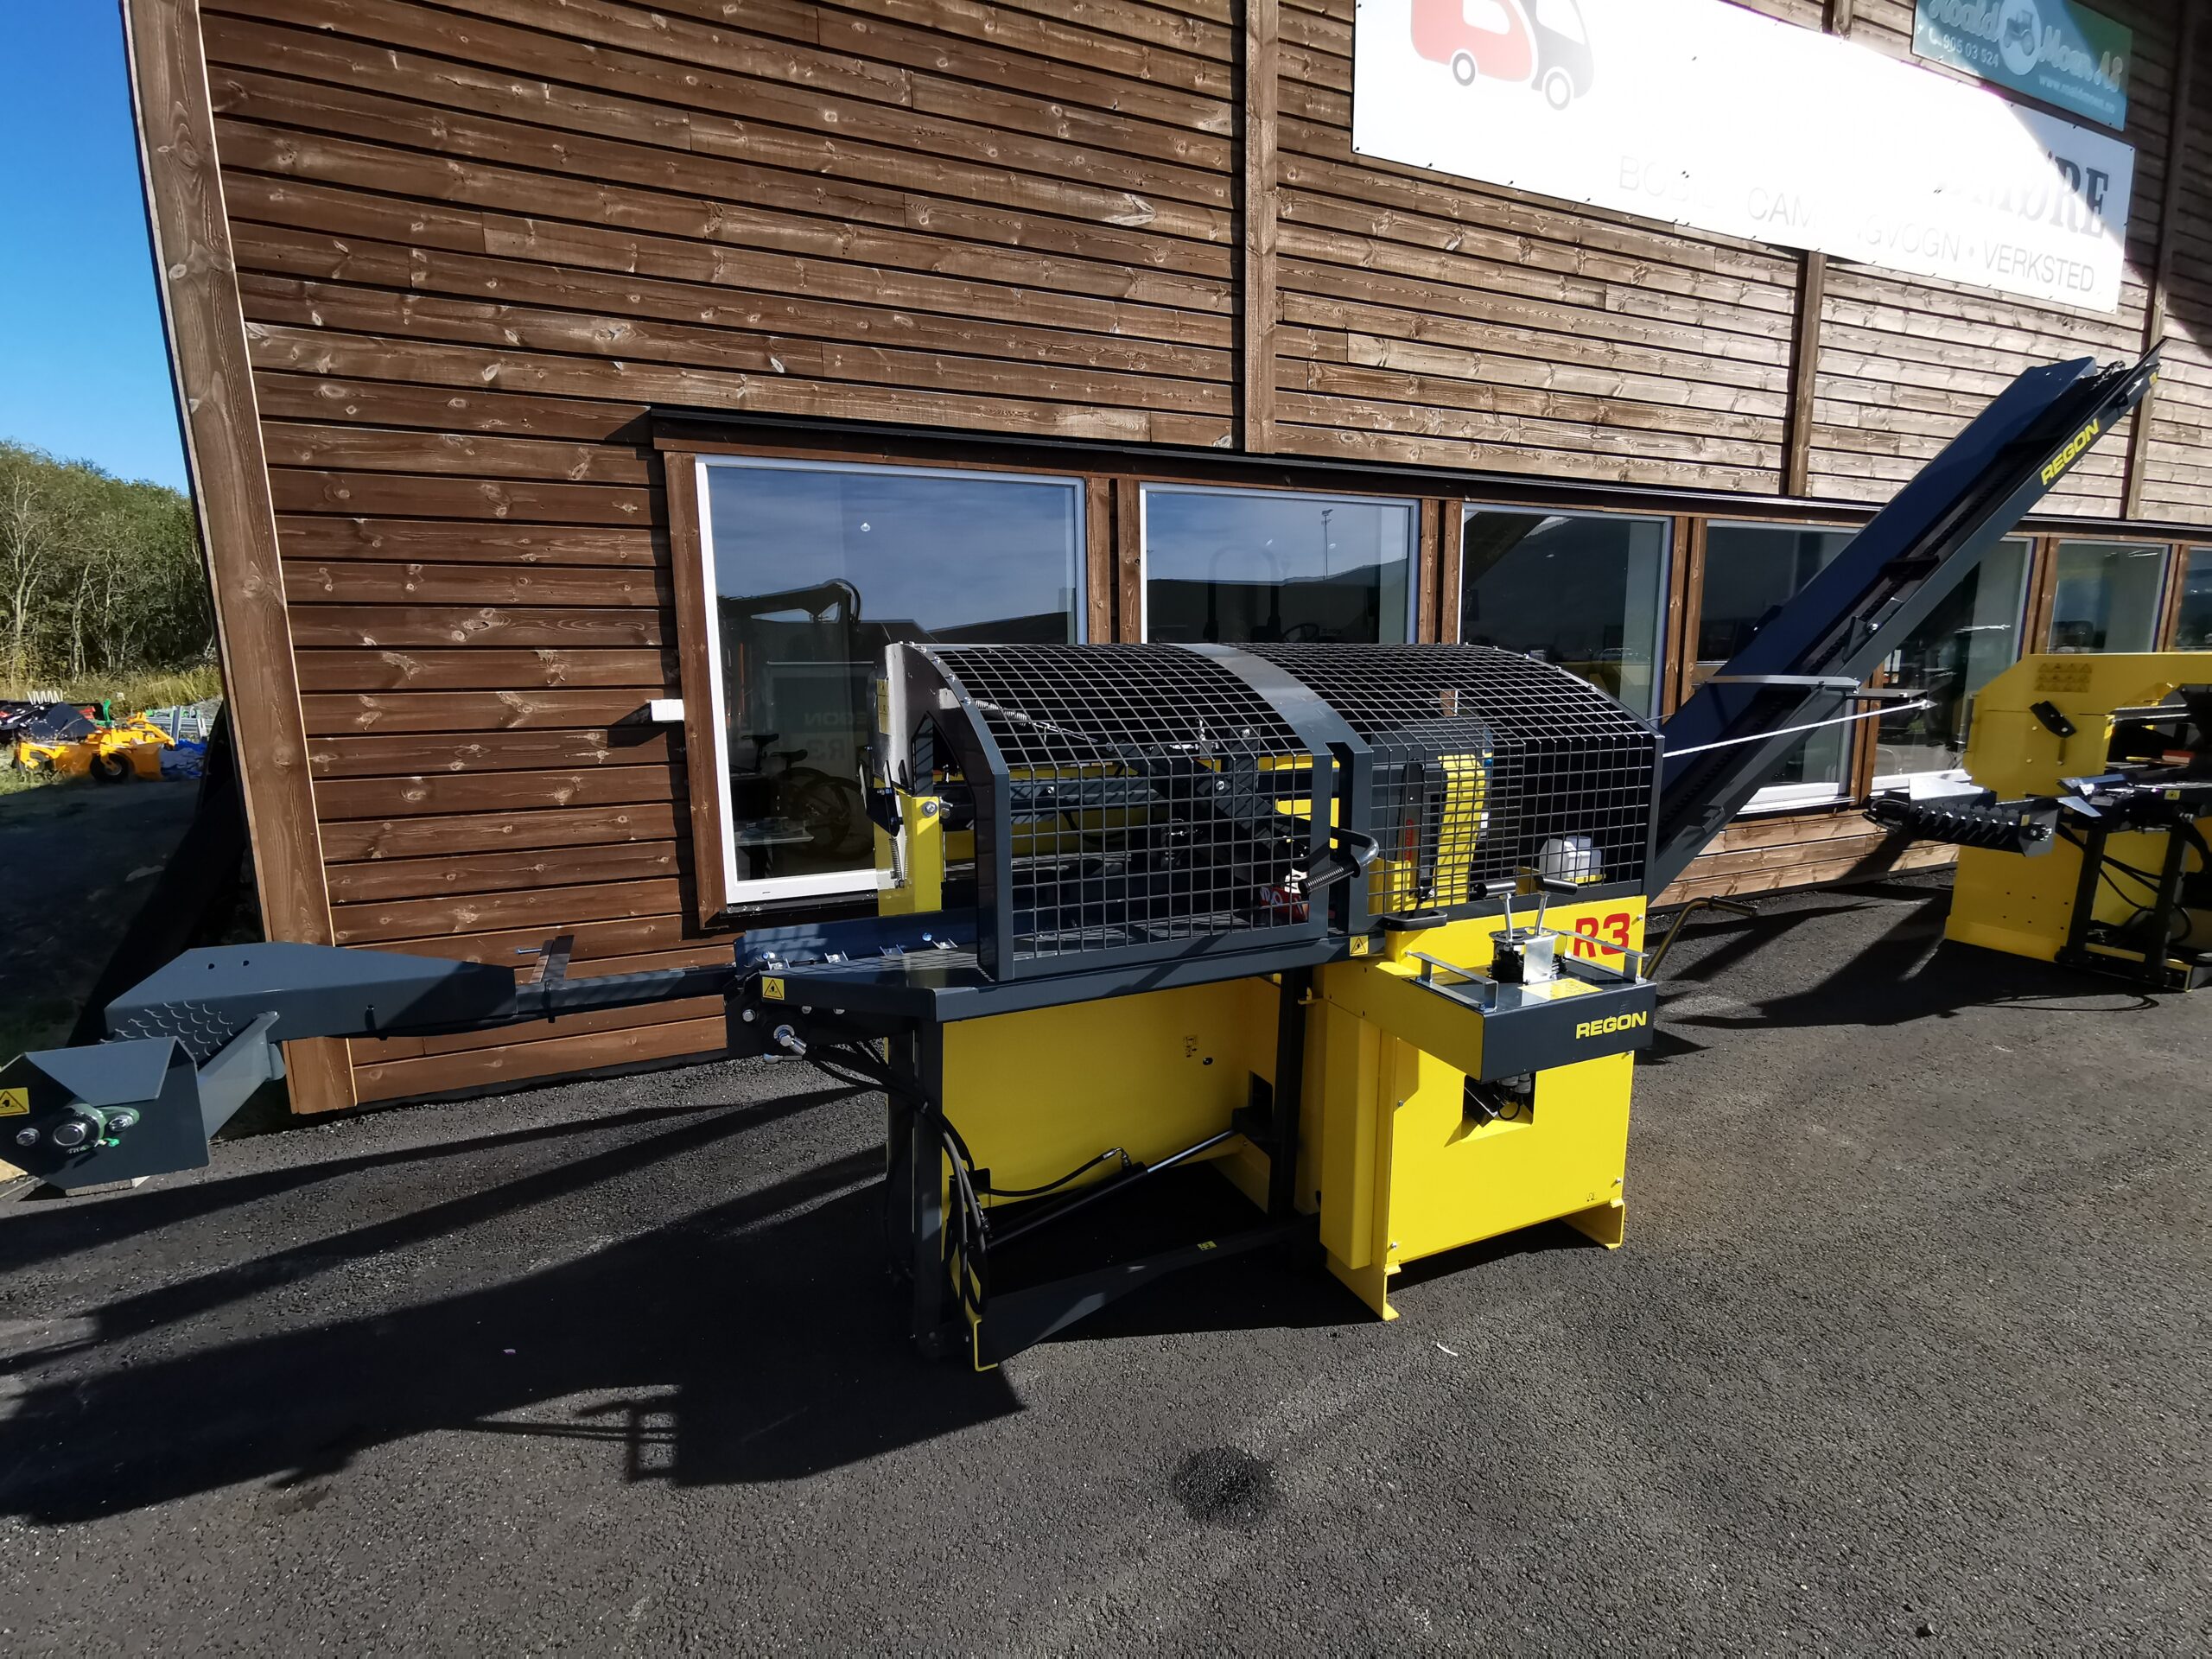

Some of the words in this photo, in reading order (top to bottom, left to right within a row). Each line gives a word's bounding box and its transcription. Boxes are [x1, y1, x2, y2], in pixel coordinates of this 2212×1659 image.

[1943, 35, 1963, 54] 905
[1965, 42, 1978, 60] 03
[1981, 48, 1999, 68] 524
[1984, 239, 2094, 293] VERKSTED
[2040, 418, 2101, 486] REGON
[1573, 912, 1630, 958] R3
[1575, 1011, 1648, 1039] REGON
